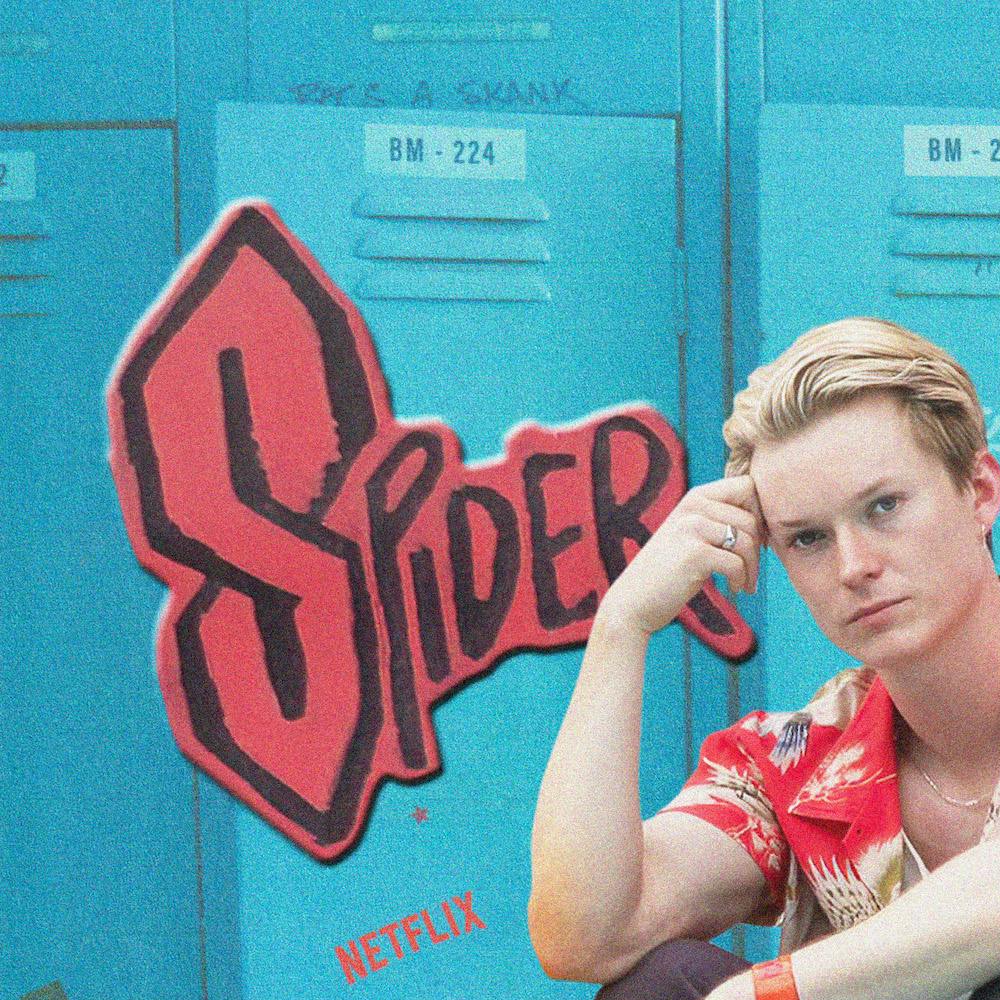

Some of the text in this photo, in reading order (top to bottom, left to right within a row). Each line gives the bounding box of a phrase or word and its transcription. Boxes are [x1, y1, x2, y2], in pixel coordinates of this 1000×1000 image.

[389, 136, 424, 163] BM
[453, 140, 496, 166] 224
[928, 137, 961, 163] BM
[334, 890, 487, 985] NETFLIX
